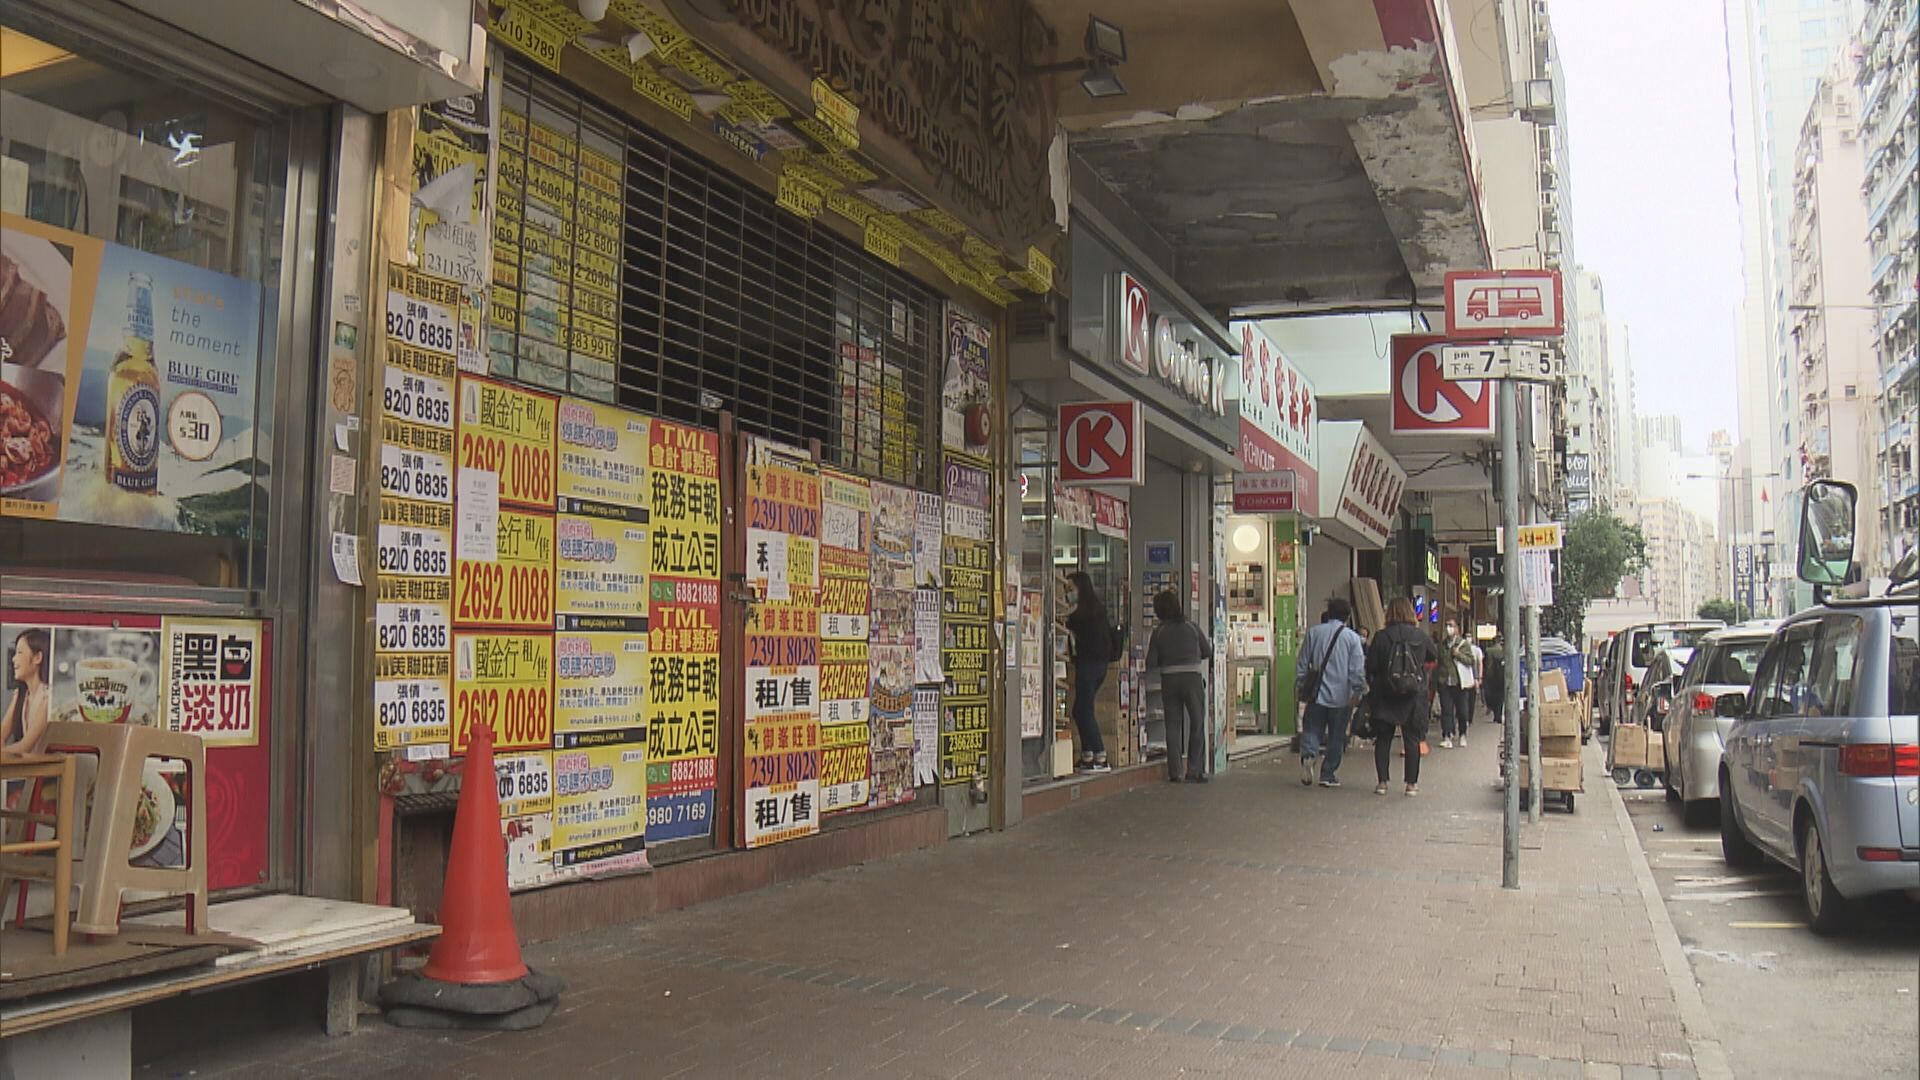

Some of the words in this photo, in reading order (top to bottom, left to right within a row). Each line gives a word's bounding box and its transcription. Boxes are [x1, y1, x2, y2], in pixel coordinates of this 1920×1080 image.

[526, 33, 556, 63] 3789
[427, 253, 483, 284] 23113878
[171, 305, 201, 328] the
[169, 329, 241, 358] moment
[419, 323, 453, 350] 6835
[167, 359, 203, 379] BLUE
[205, 369, 238, 387] GIRL
[1450, 363, 1475, 375] 下午
[1453, 352, 1470, 360] pm
[1479, 351, 1495, 373] 7
[1539, 354, 1551, 375] 5
[1211, 357, 1225, 417] K
[416, 397, 450, 424] 6835
[659, 424, 711, 455] TML
[1067, 411, 1127, 472] K
[511, 443, 551, 501] 0088
[651, 443, 718, 478] 會計事務所
[415, 473, 448, 498] 6835
[751, 497, 783, 533] 2391
[787, 505, 818, 538] 8028
[413, 549, 447, 574] 6835
[651, 525, 719, 578] 成立公司
[458, 561, 504, 620] 2692
[509, 565, 550, 622] 0088
[676, 582, 718, 605] 68821888
[658, 606, 712, 628] TML
[412, 625, 446, 648] 6835
[651, 628, 718, 653] 會計事務所
[750, 636, 782, 666] 2391
[786, 637, 817, 666] 8028
[755, 677, 812, 709] 租/售
[821, 664, 868, 701] 23841838
[182, 683, 251, 731] 淡奶
[411, 700, 445, 724] 6835
[504, 688, 547, 743] 0088
[647, 709, 717, 761] 成立公司
[671, 757, 715, 783] 68821888
[750, 754, 782, 789] 2391
[786, 749, 817, 782] 8028
[820, 747, 868, 788] 23841838
[518, 772, 549, 795] 6835
[677, 802, 707, 823] 7169
[755, 791, 812, 830] 租/售
